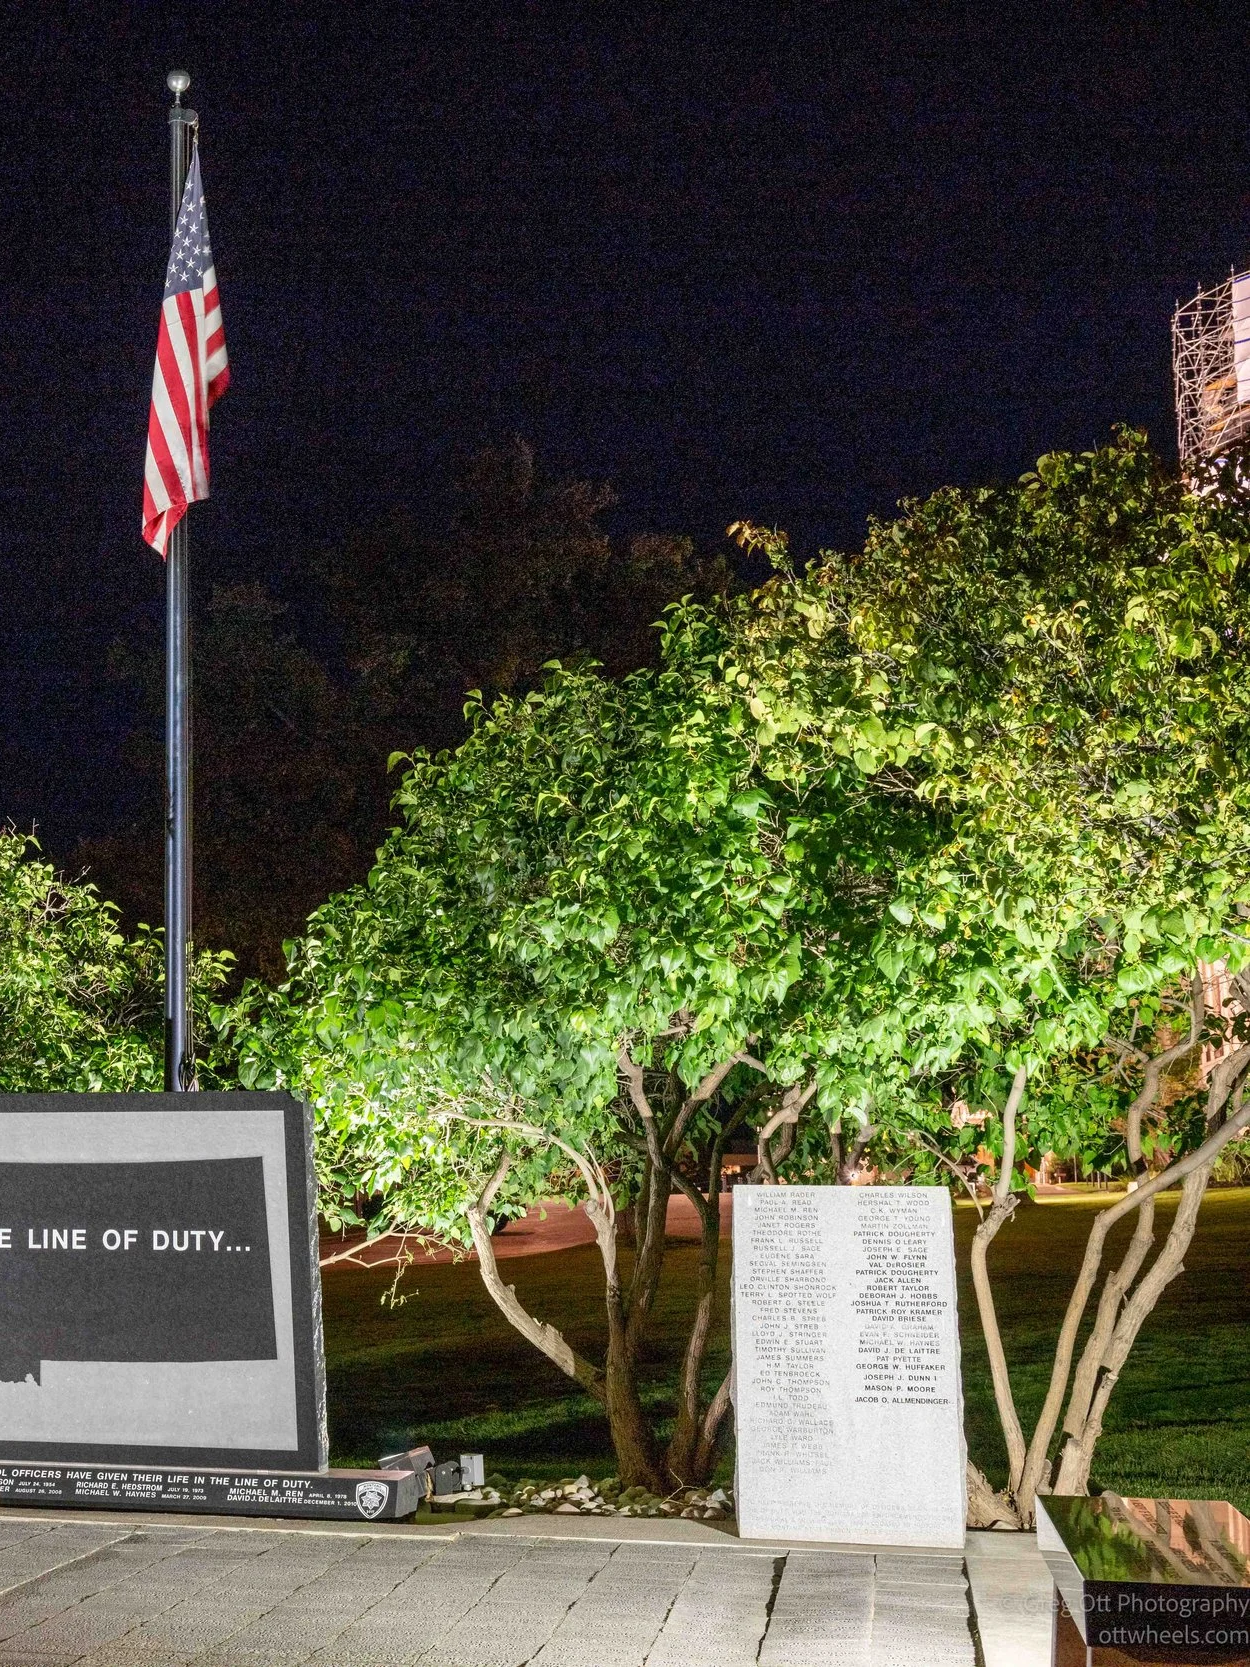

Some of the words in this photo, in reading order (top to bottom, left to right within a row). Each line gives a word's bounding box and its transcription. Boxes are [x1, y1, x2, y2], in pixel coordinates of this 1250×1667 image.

[28, 1229, 87, 1249] LINE
[102, 1229, 138, 1250] OF
[152, 1230, 251, 1252] DUTY...
[12, 1470, 62, 1478] OFFICERS
[66, 1471, 92, 1479] HAVE
[97, 1472, 128, 1481] GIVEN
[132, 1474, 163, 1482] THEIR
[168, 1475, 189, 1483] LIFE
[194, 1476, 205, 1484] IN
[210, 1477, 230, 1486] THE
[235, 1478, 258, 1487] LINE
[283, 1480, 313, 1489] DUTY.
[75, 1488, 110, 1496] MICHAEL
[230, 1488, 267, 1496] MICHAEL
